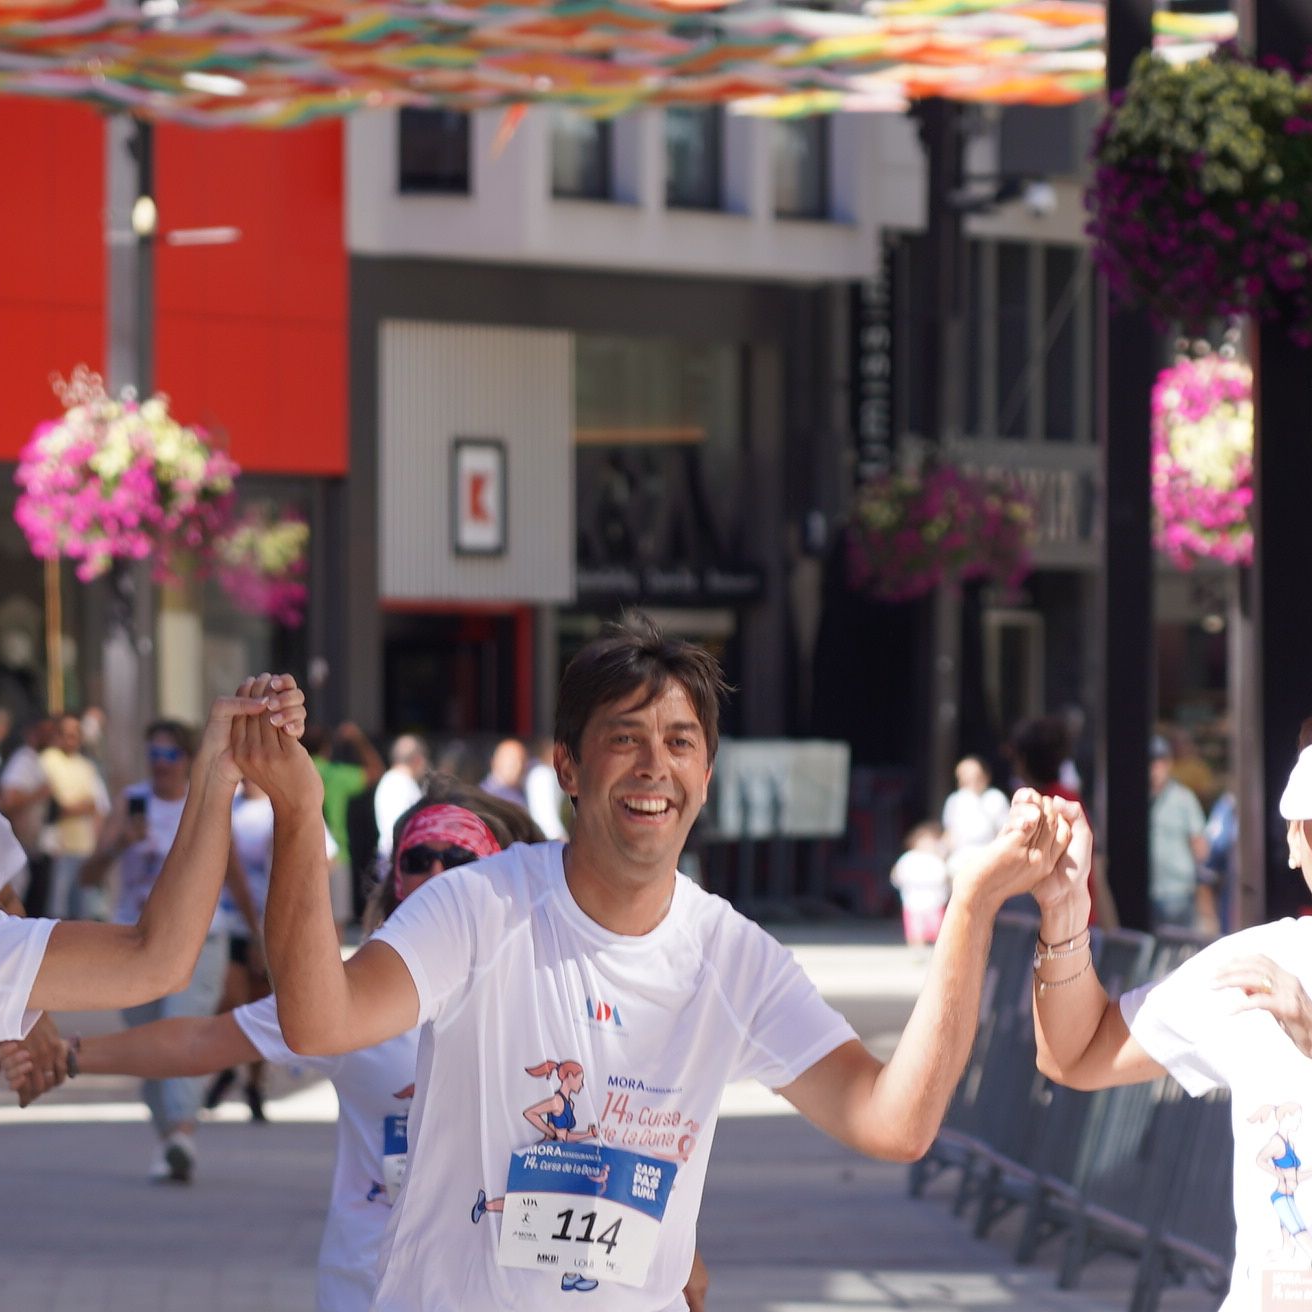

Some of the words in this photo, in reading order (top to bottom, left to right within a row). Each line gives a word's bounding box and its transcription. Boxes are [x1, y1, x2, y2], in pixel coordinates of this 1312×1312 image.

[608, 1075, 645, 1092] MORA
[639, 1106, 681, 1128] Cursa
[622, 1128, 638, 1146] la
[526, 1144, 562, 1158] MORA
[635, 1162, 662, 1179] CADA
[633, 1173, 660, 1190] PAS
[632, 1184, 656, 1201] SUMA
[551, 1208, 623, 1255] 114
